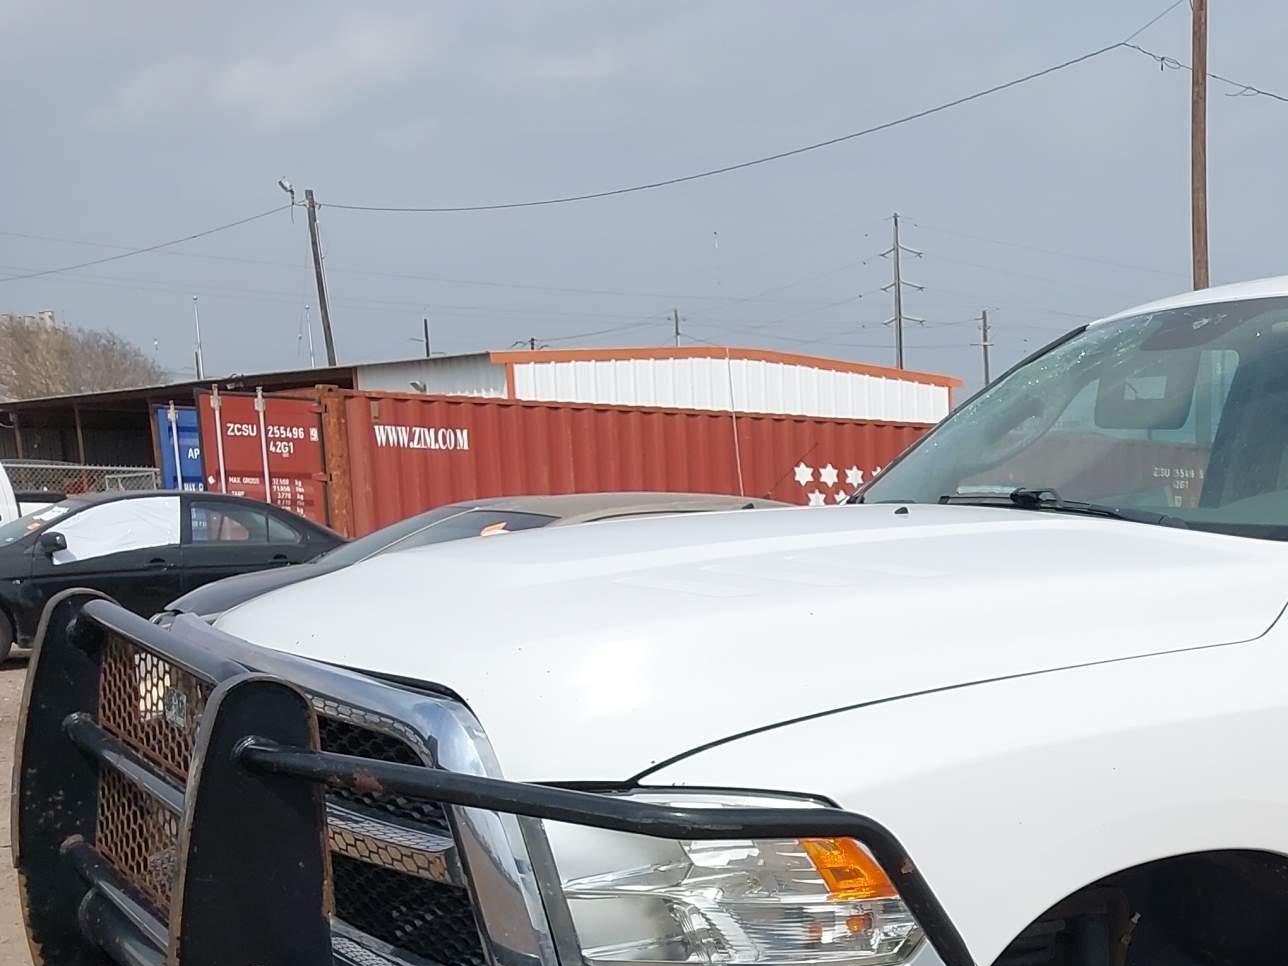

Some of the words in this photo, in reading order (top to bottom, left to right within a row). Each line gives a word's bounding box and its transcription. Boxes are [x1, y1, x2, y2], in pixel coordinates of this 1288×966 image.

[226, 423, 257, 436] ZCSU
[267, 425, 305, 439] 255496
[269, 441, 294, 453] 42G1
